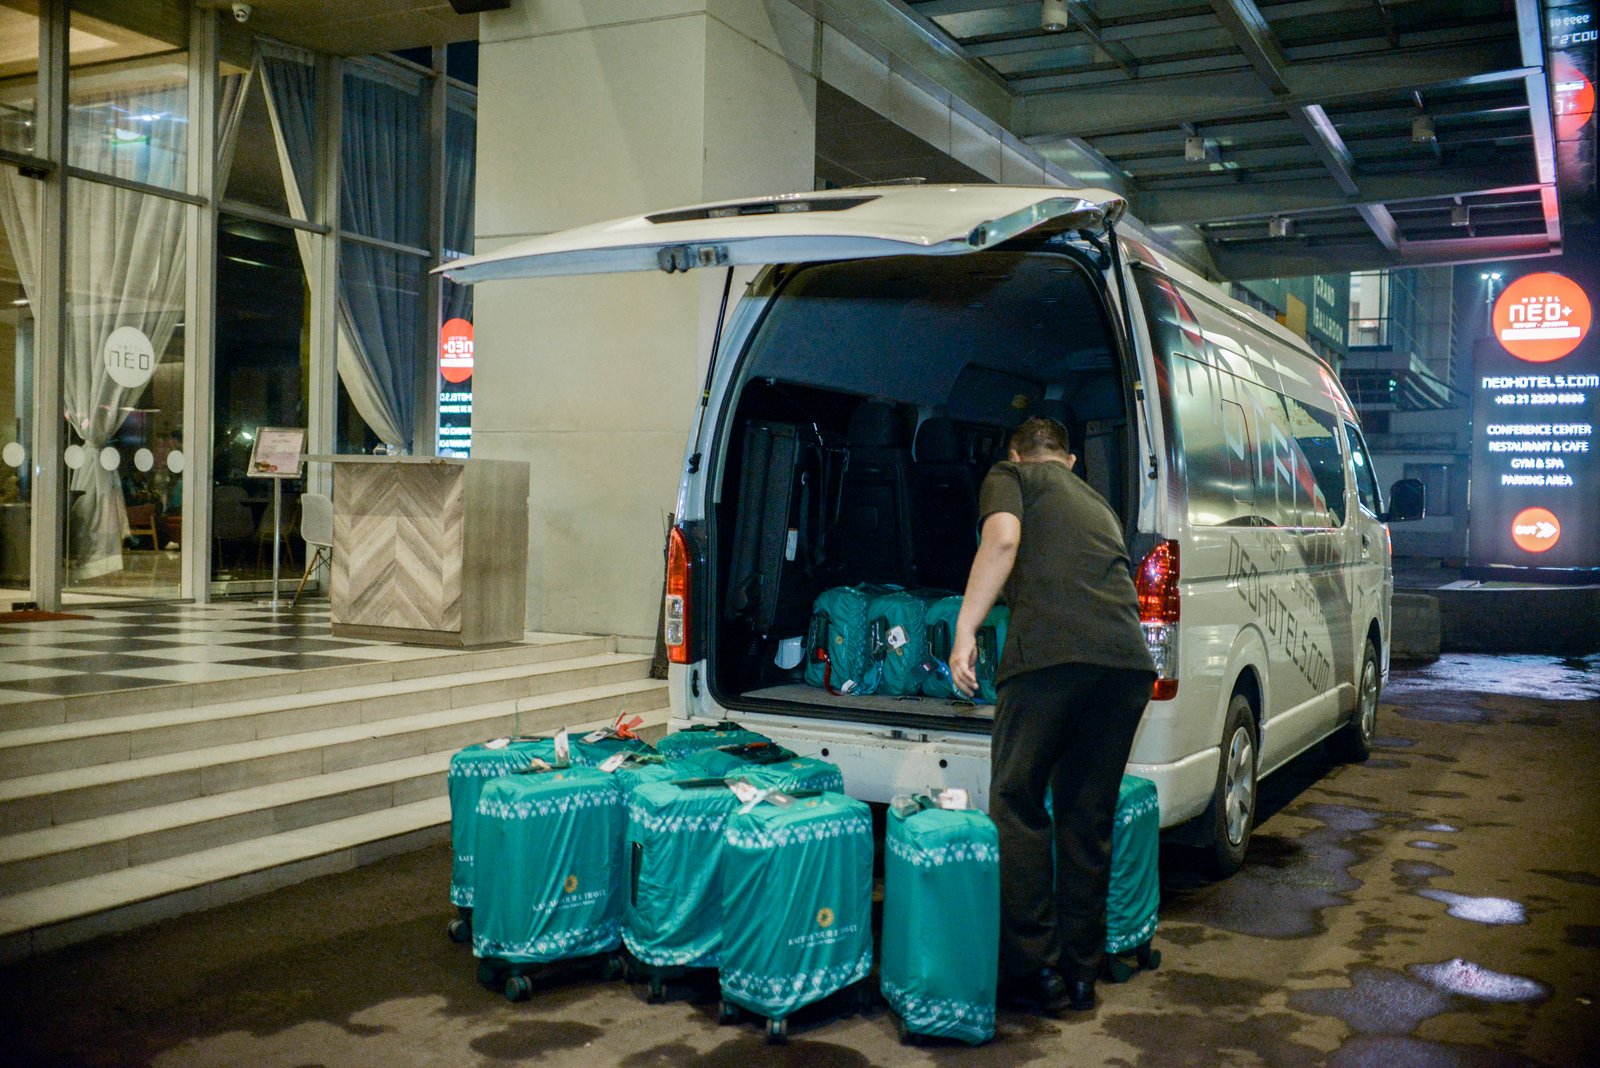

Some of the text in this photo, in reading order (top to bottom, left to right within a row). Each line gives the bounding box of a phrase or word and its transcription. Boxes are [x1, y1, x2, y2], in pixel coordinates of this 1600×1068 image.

[1521, 296, 1561, 304] HOTEL
[109, 350, 149, 370] NEO
[1482, 375, 1599, 389] NEOHOTELS.COM
[1486, 424, 1592, 435] CONFERENCE CENTER
[1489, 441, 1552, 452] RESTAURANT
[1562, 441, 1589, 452] CAFE
[1511, 458, 1535, 469] GYM
[1545, 458, 1565, 469] SPA
[1502, 475, 1574, 486] PARKING AREA
